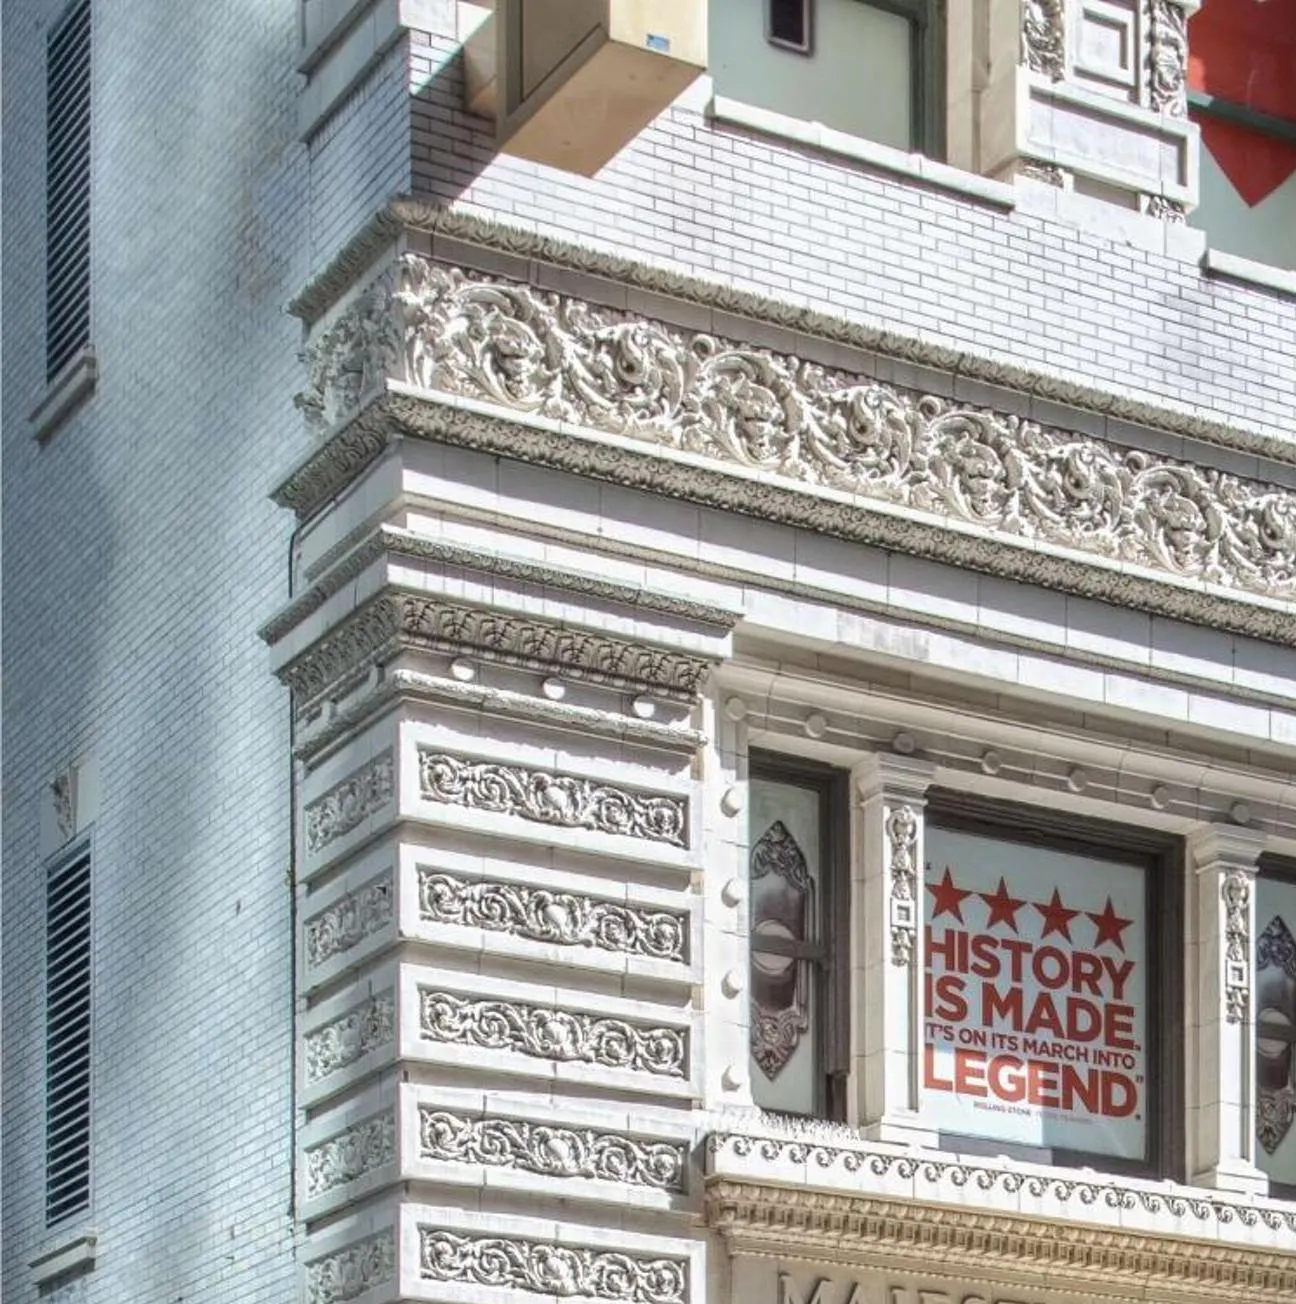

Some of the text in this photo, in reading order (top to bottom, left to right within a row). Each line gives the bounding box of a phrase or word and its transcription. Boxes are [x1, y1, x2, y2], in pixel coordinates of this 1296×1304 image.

[924, 925, 1136, 1000] HISTORY
[924, 973, 968, 1022] IS
[959, 1027, 987, 1049] ON
[992, 1033, 1018, 1052] ITS
[1023, 1038, 1088, 1064] MARCH
[1093, 1049, 1136, 1070] INTO
